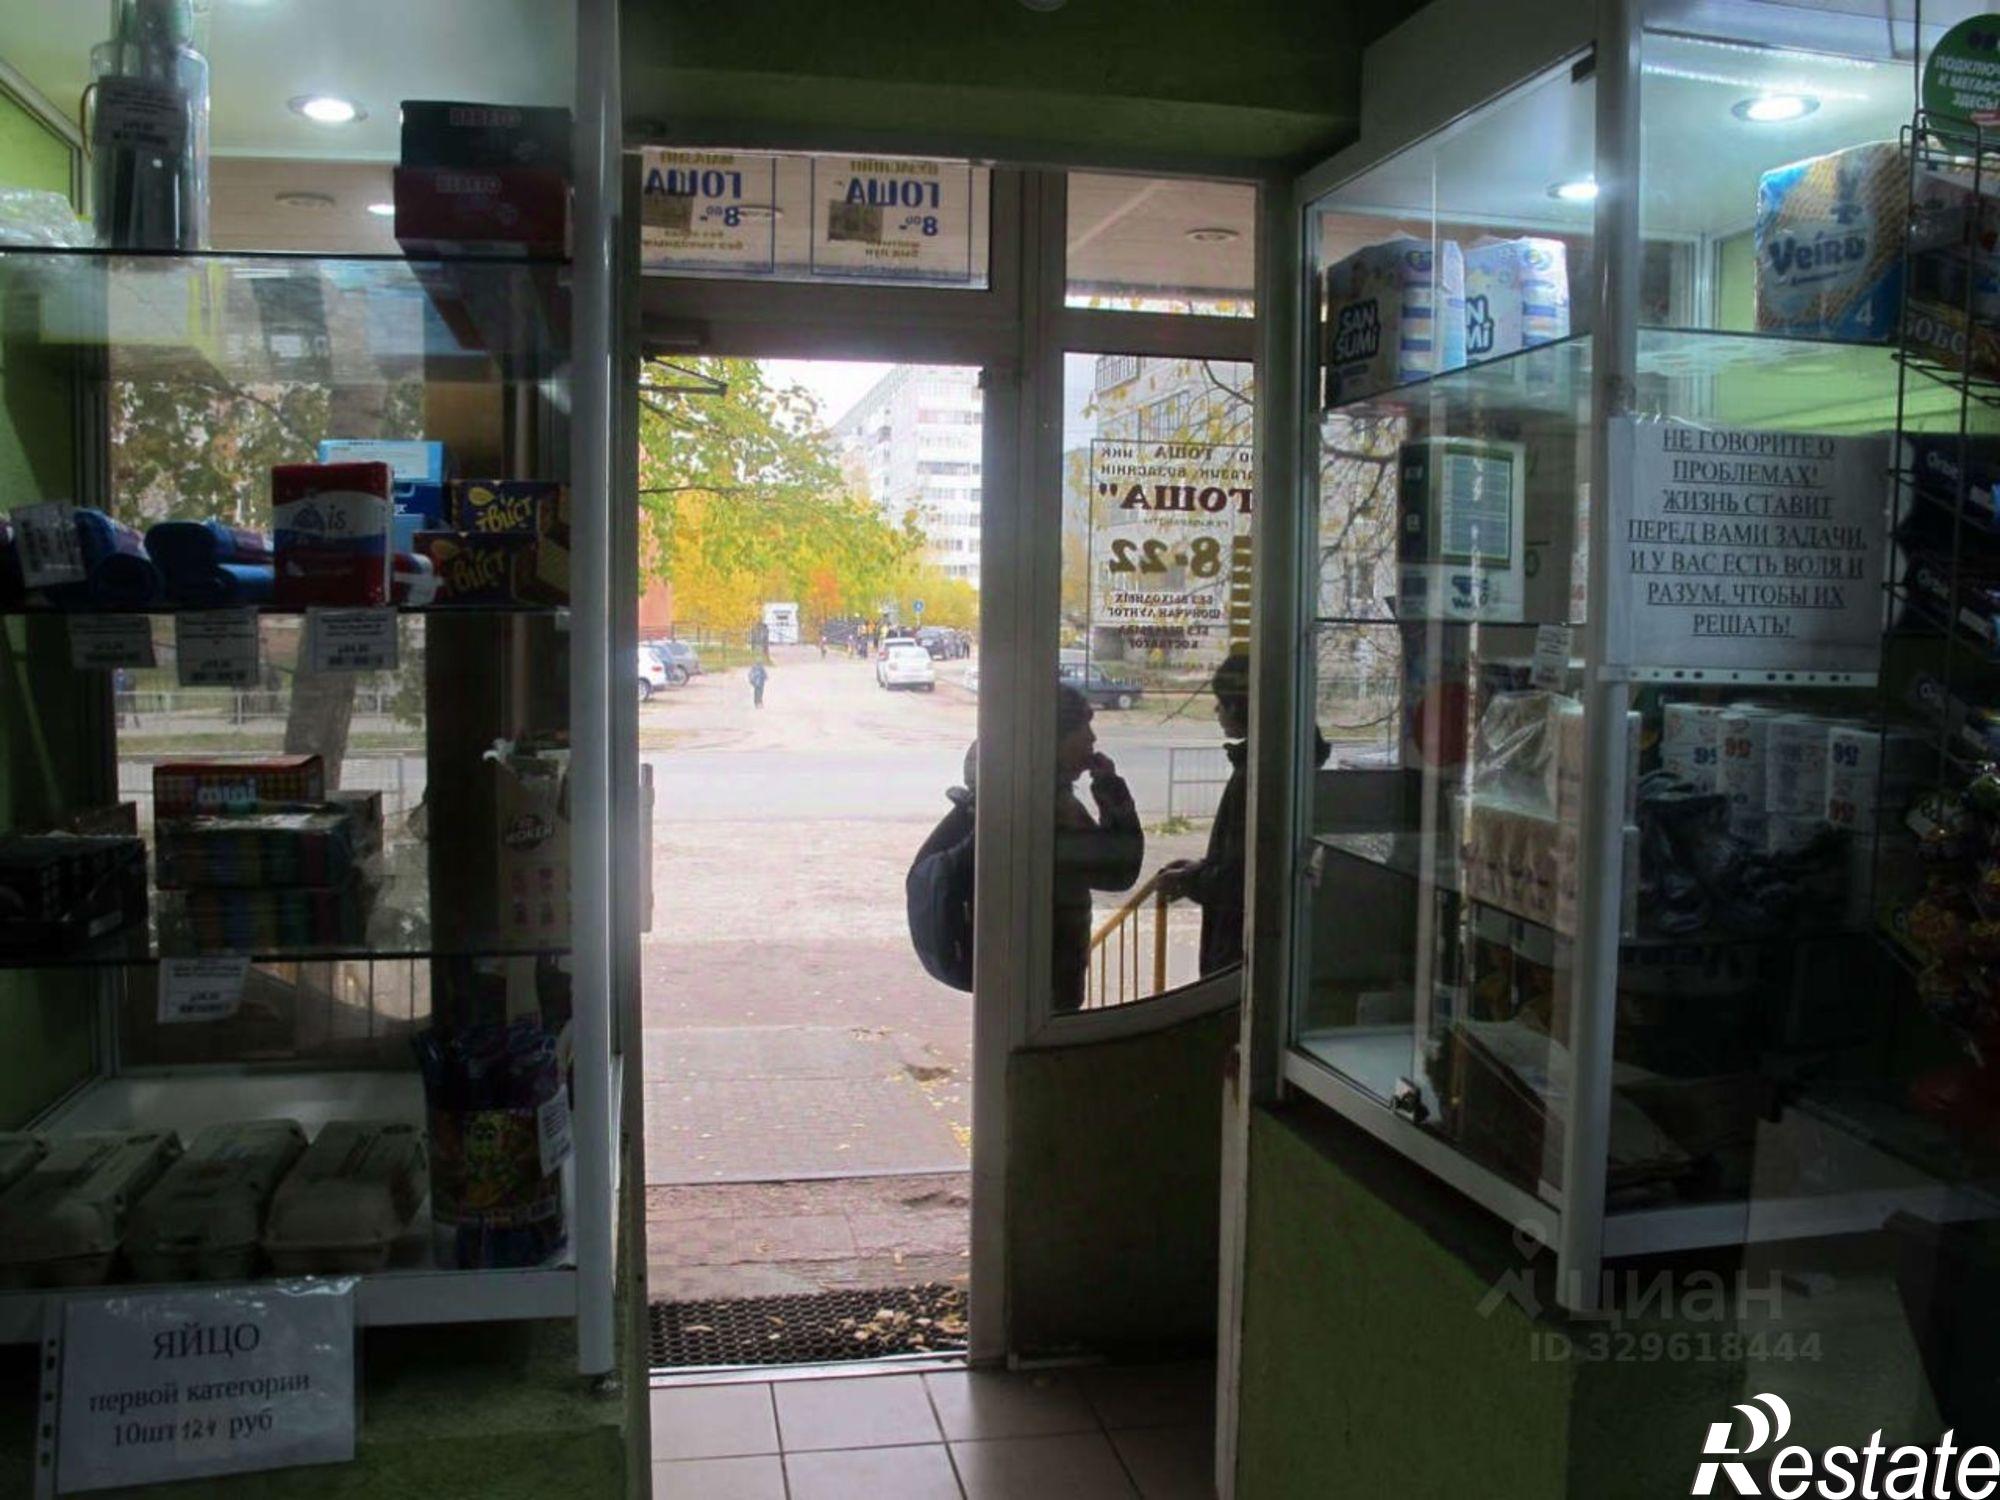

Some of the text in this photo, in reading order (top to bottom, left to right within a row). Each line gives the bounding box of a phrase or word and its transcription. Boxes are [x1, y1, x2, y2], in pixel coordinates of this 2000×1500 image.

[1855, 301, 1875, 327] 4
[1663, 428, 1835, 457] НЕ ГОВОРИТЕ О
[1673, 458, 1819, 486] ПРОБЛЕМАХ!
[1663, 488, 1832, 517] ЖИЗНЬ СТАВИТ
[1627, 518, 1868, 551] ПЕРЕД ВАМИ ЗАДАЧИ,
[1631, 550, 1864, 579] И У ВАС ЕСТЬ ВОЛЯ И
[1648, 581, 1845, 608] РАЗУМ, ЧТОБЫ ИХ
[1693, 613, 1792, 636] РЕШАТЬ!
[153, 1322, 260, 1360] ЯЙЦО
[89, 1374, 310, 1414] первой категории
[113, 1420, 176, 1447] 10шт
[229, 1408, 273, 1440] руб
